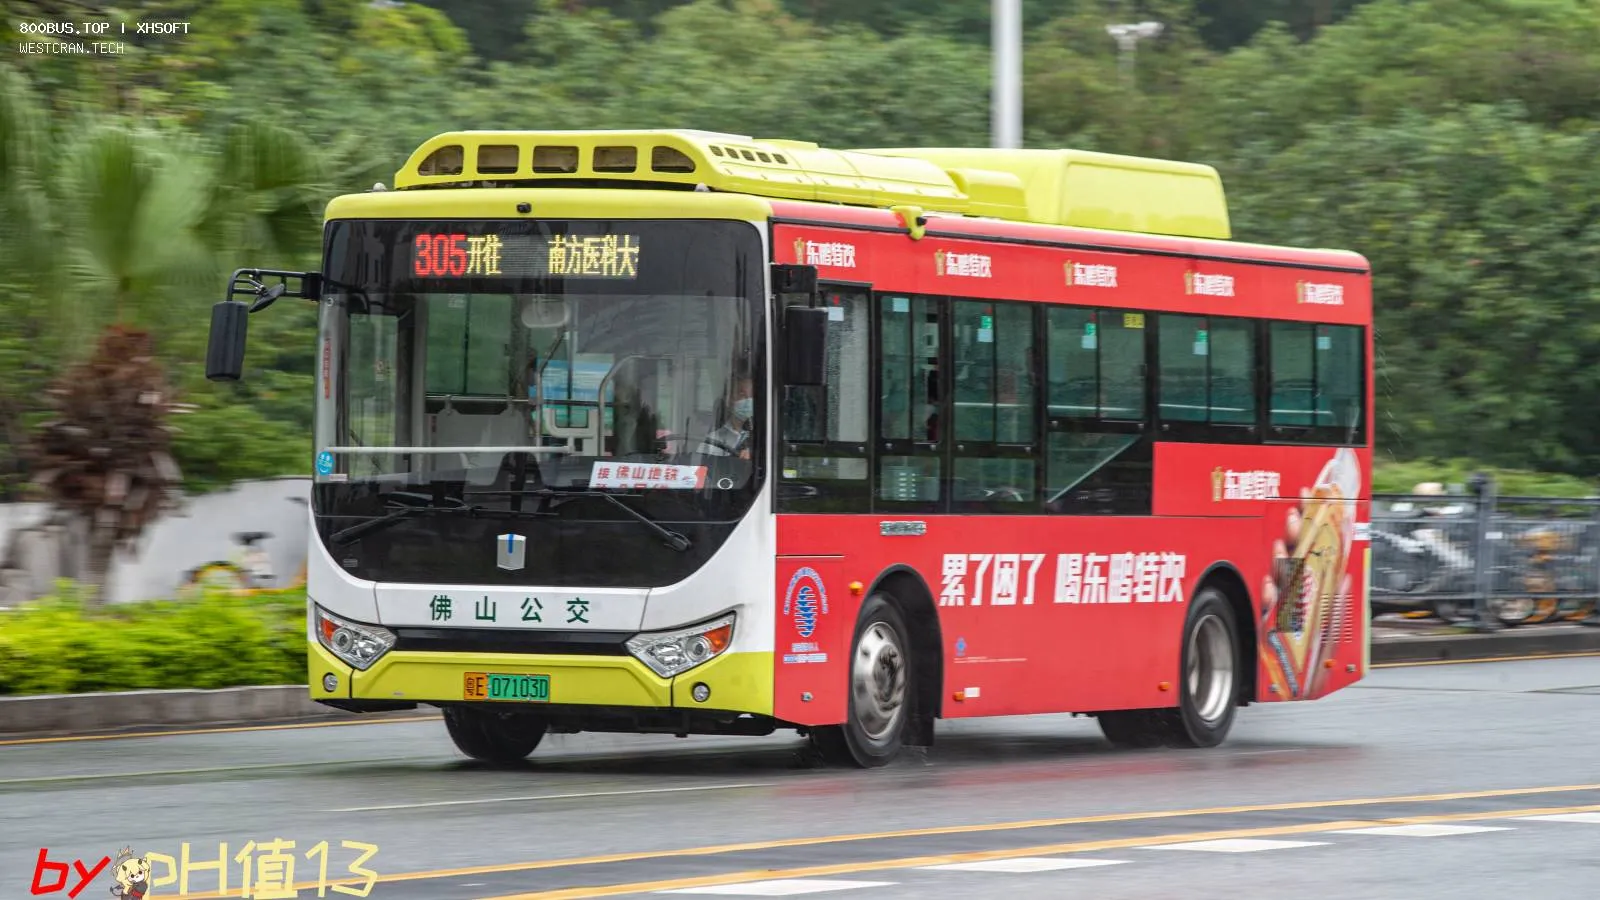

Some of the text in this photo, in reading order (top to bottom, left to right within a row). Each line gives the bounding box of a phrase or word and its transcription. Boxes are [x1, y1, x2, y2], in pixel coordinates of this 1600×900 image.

[414, 234, 466, 276] 305
[547, 234, 640, 276] 南方医科大
[938, 553, 1048, 607] 累了困了
[429, 594, 590, 624] 佛山公交
